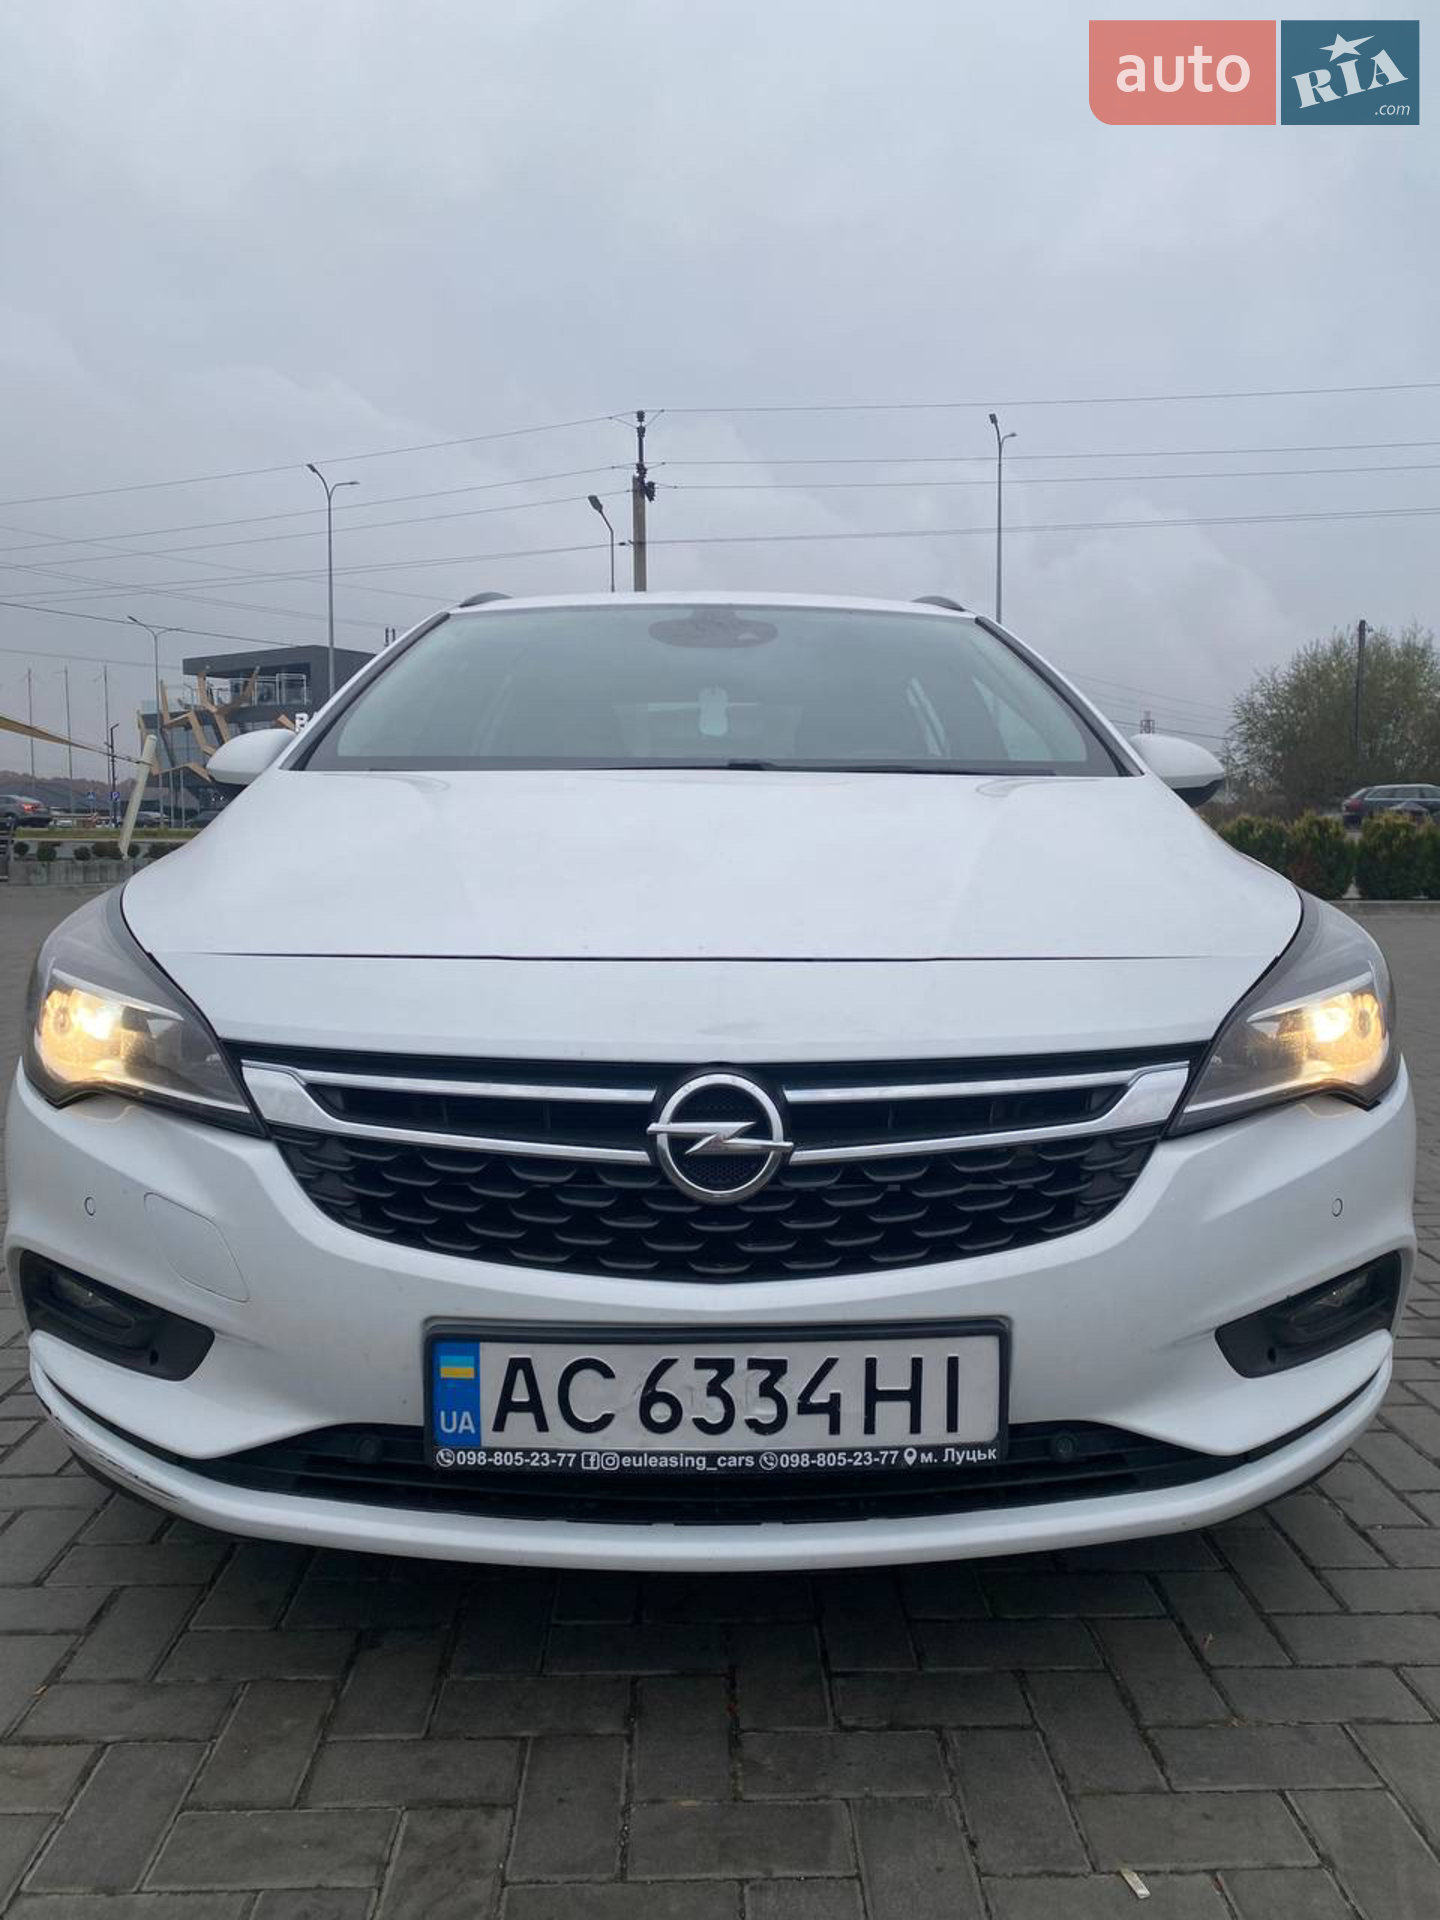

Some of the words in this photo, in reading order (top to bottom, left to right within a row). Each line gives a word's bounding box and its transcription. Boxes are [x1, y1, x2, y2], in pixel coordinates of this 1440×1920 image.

[440, 1411, 475, 1434] UA
[456, 1452, 577, 1467] 098-805-23-77
[621, 1453, 755, 1471] euleasing_cars
[779, 1451, 898, 1468] 098-805-23-77
[942, 1447, 997, 1465] Луцьк
